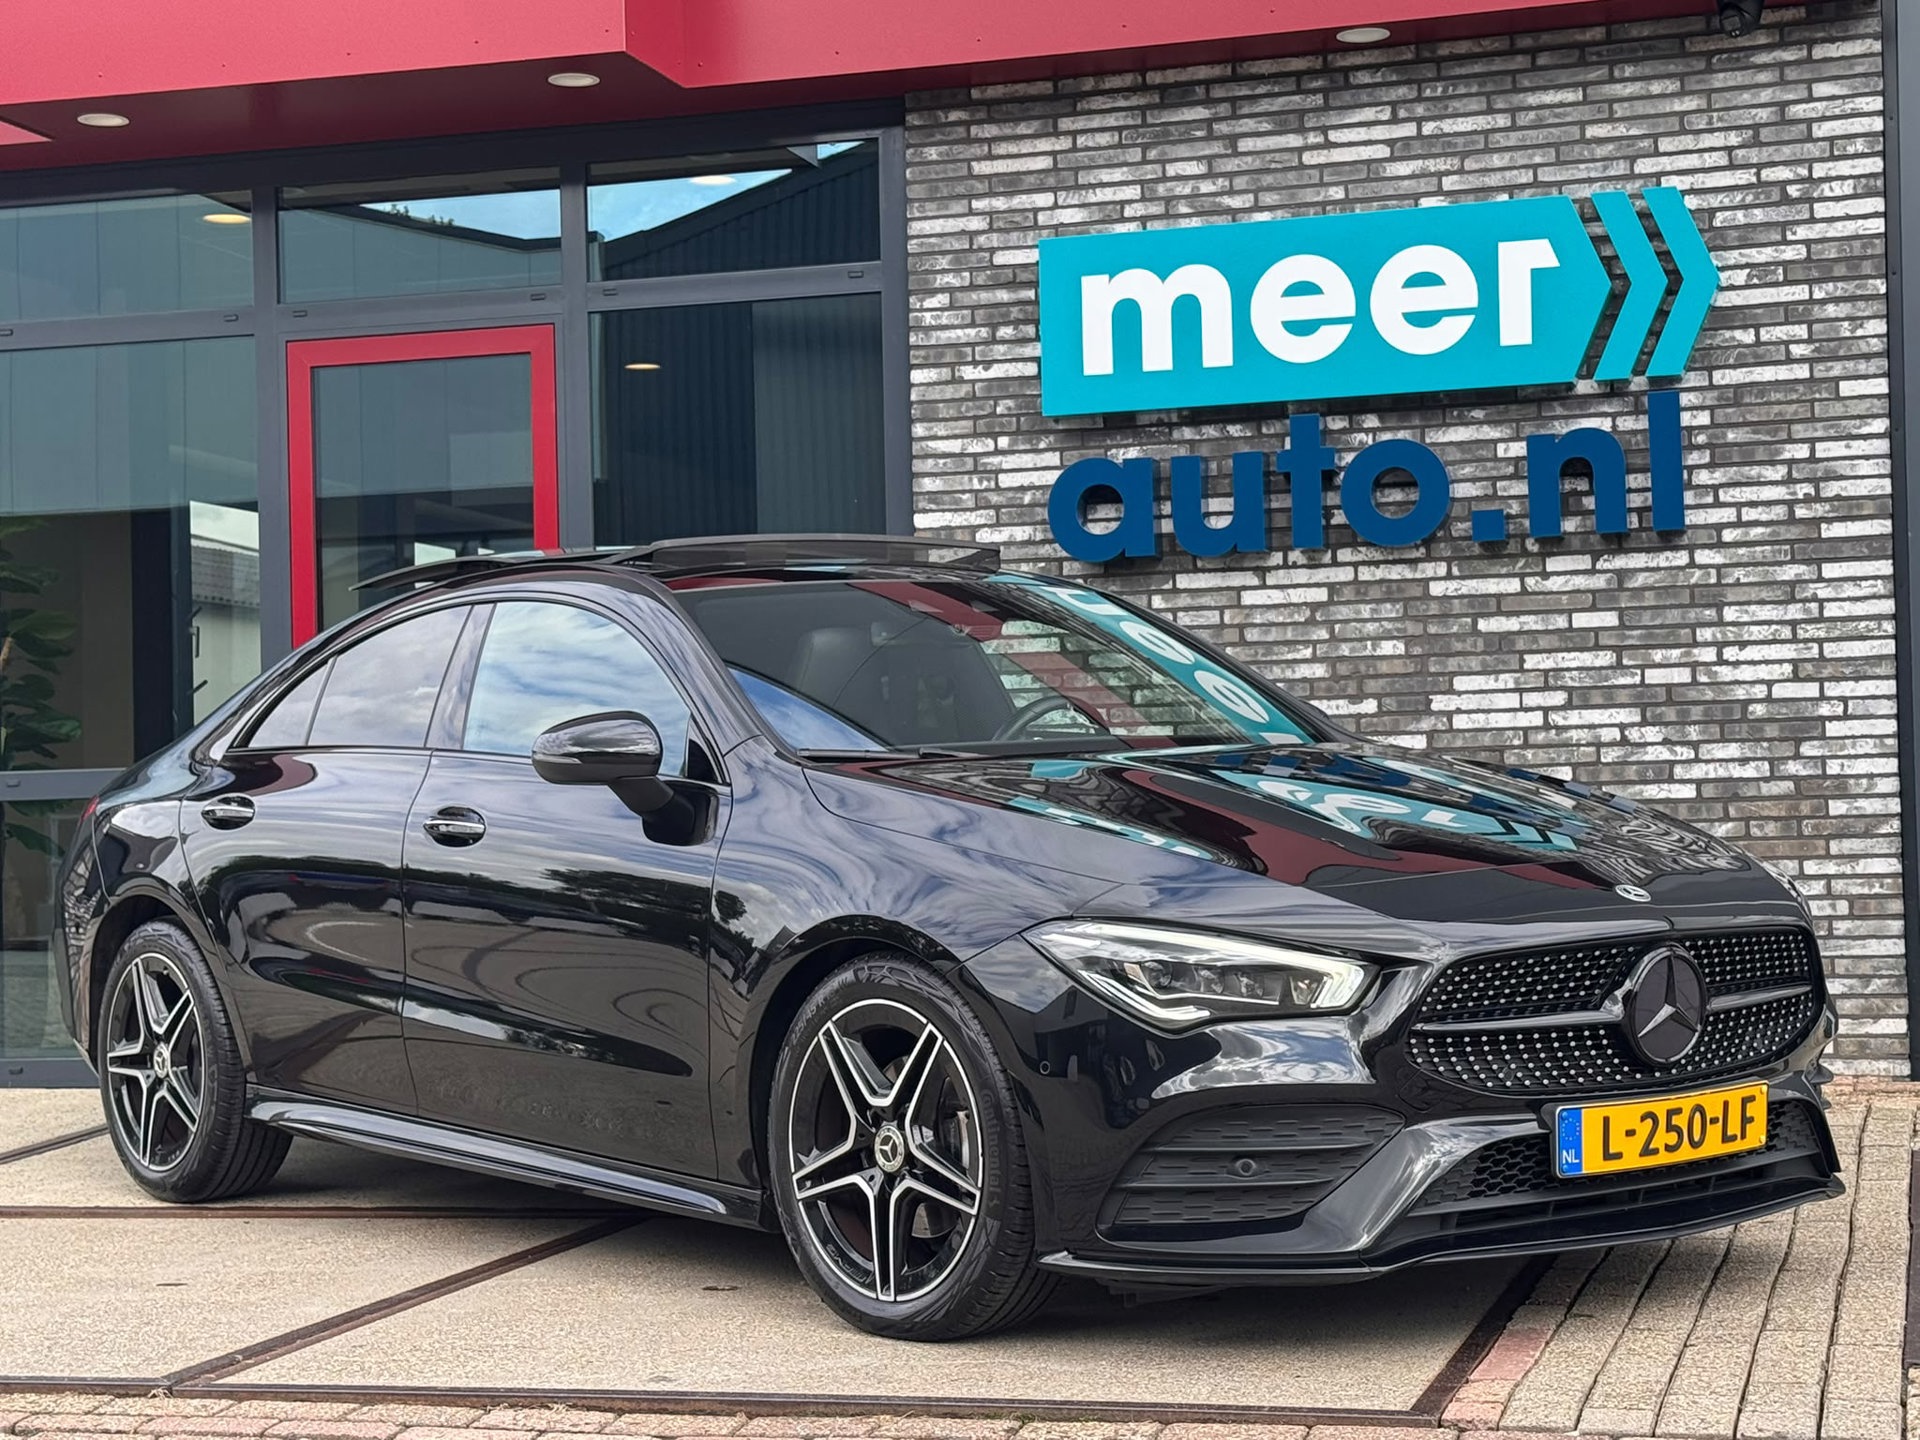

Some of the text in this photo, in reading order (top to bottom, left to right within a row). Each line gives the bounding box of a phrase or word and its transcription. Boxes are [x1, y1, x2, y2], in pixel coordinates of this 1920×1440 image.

[1080, 238, 1560, 376] meer
[1047, 390, 1688, 563] auto.nl
[980, 1088, 1001, 1193] Continental
[1562, 1148, 1580, 1164] NL
[1602, 1094, 1757, 1162] L-250-LF
